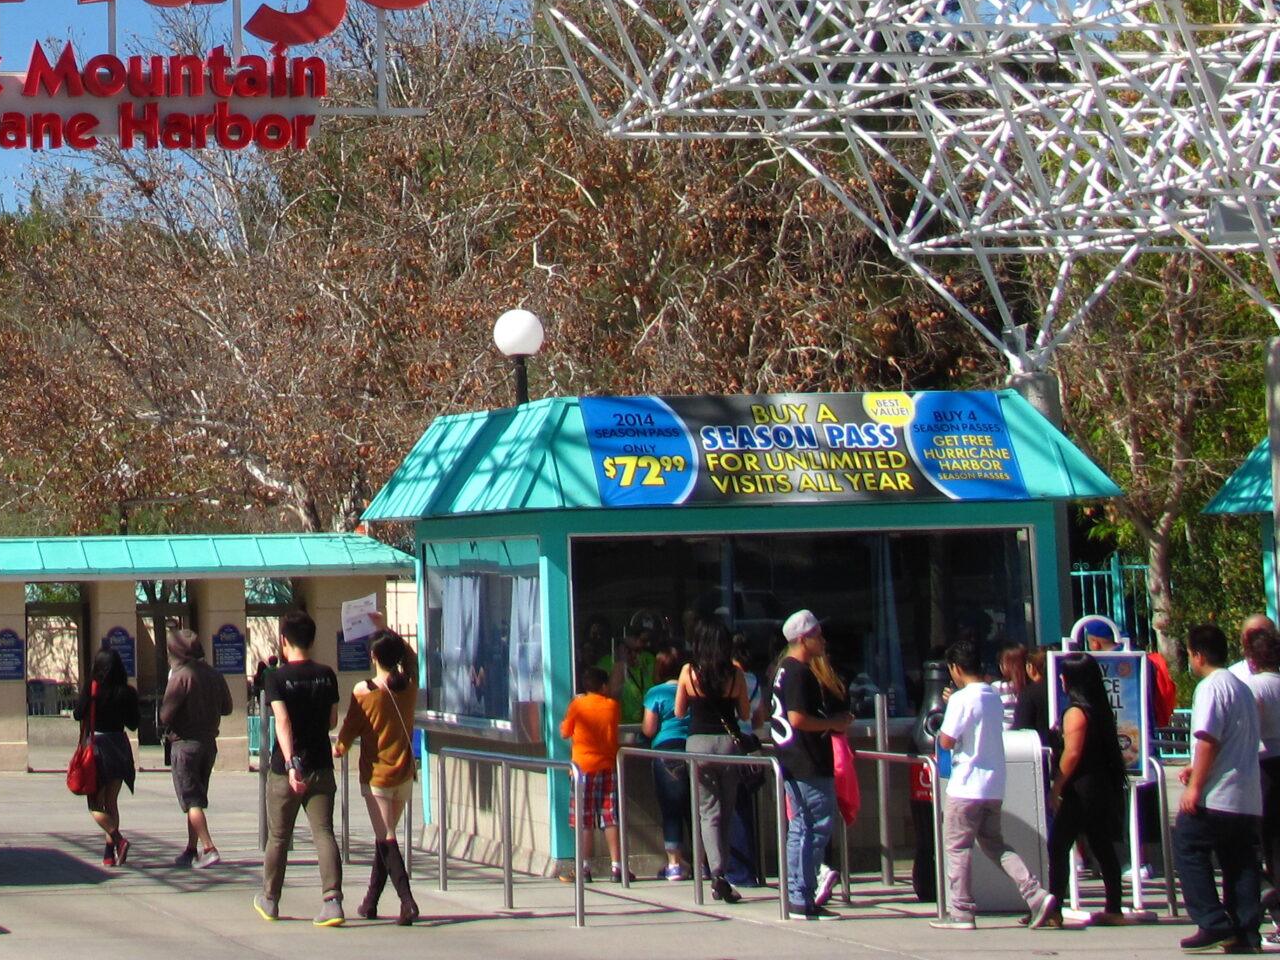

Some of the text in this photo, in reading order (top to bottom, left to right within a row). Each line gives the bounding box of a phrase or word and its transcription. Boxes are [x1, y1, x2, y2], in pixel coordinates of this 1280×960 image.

[22, 39, 327, 97] Mountain
[119, 102, 316, 149] Harbor
[876, 399, 900, 407] BEST
[751, 403, 840, 423] BUY A
[871, 407, 910, 416] VALUE!
[933, 410, 977, 422] BUY 4
[613, 413, 655, 426] 2014
[594, 427, 680, 438] SEASON PASS
[913, 424, 961, 433] SEASON
[700, 423, 897, 451] SEASON PASS
[932, 435, 994, 447] GET FREE
[623, 444, 656, 453] ONLY
[923, 448, 1010, 459] HURRICANE
[705, 450, 908, 472] FOR UNLIMITED
[938, 460, 1002, 470] HARBOR
[937, 472, 1010, 480] SEASON PASSES
[710, 472, 915, 494] VISITS ALL YEAR
